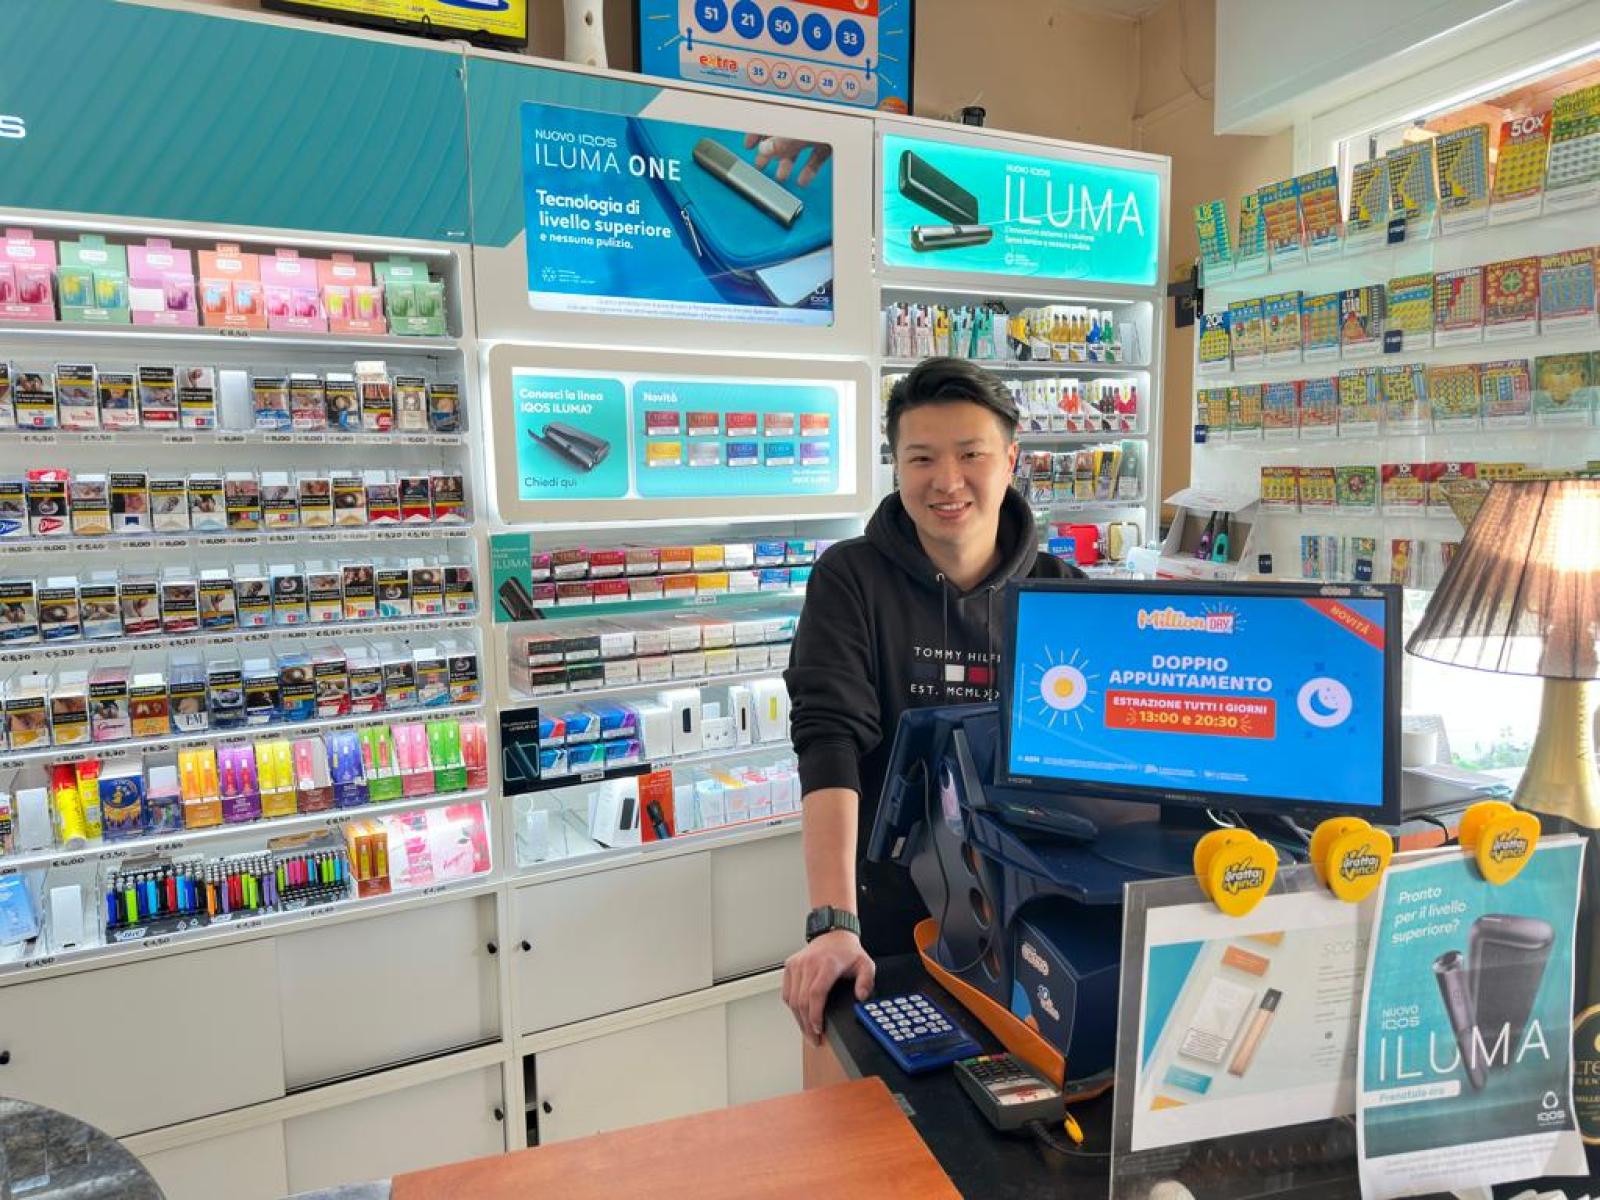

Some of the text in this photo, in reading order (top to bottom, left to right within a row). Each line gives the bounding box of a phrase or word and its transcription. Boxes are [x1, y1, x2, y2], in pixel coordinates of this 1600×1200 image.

[704, 7, 857, 45] 51 21 50 6 33
[753, 66, 765, 77] 35
[777, 70, 788, 80] 27
[800, 74, 811, 84] 43
[846, 81, 856, 91] 10
[1510, 113, 1546, 137] 50X
[535, 129, 618, 149] NUOVO IQOS
[535, 143, 681, 182] ILUMA ONE
[535, 189, 640, 217] Tecnologia di
[1004, 174, 1145, 238] ILUMA
[538, 210, 672, 240] livello superiore
[540, 233, 634, 250] e nessuna pulizia.
[519, 387, 604, 402] Conosci la linea
[520, 402, 592, 415] IQOS ILUMA?
[524, 477, 577, 490] Chiedi qui
[1138, 607, 1207, 631] Million
[913, 646, 962, 662] TOMMY
[1152, 654, 1229, 673] DOPPIO
[910, 684, 939, 696] EST.
[1109, 670, 1273, 693] APPUNTAMENTO
[1113, 696, 1182, 711] ESTRAZIONE
[1184, 700, 1219, 712] TUTTI
[1225, 703, 1268, 716] GIORNI
[1139, 711, 1239, 728] 13:00 e 20:30
[1399, 886, 1443, 905] Pronto
[1393, 900, 1467, 928] per il livello
[1391, 918, 1461, 946] superiore?
[1382, 1005, 1419, 1018] NUOVO
[1382, 1017, 1421, 1031] IQOS
[1379, 1018, 1551, 1082] ILUMA
[1537, 1110, 1566, 1124] IQOS
